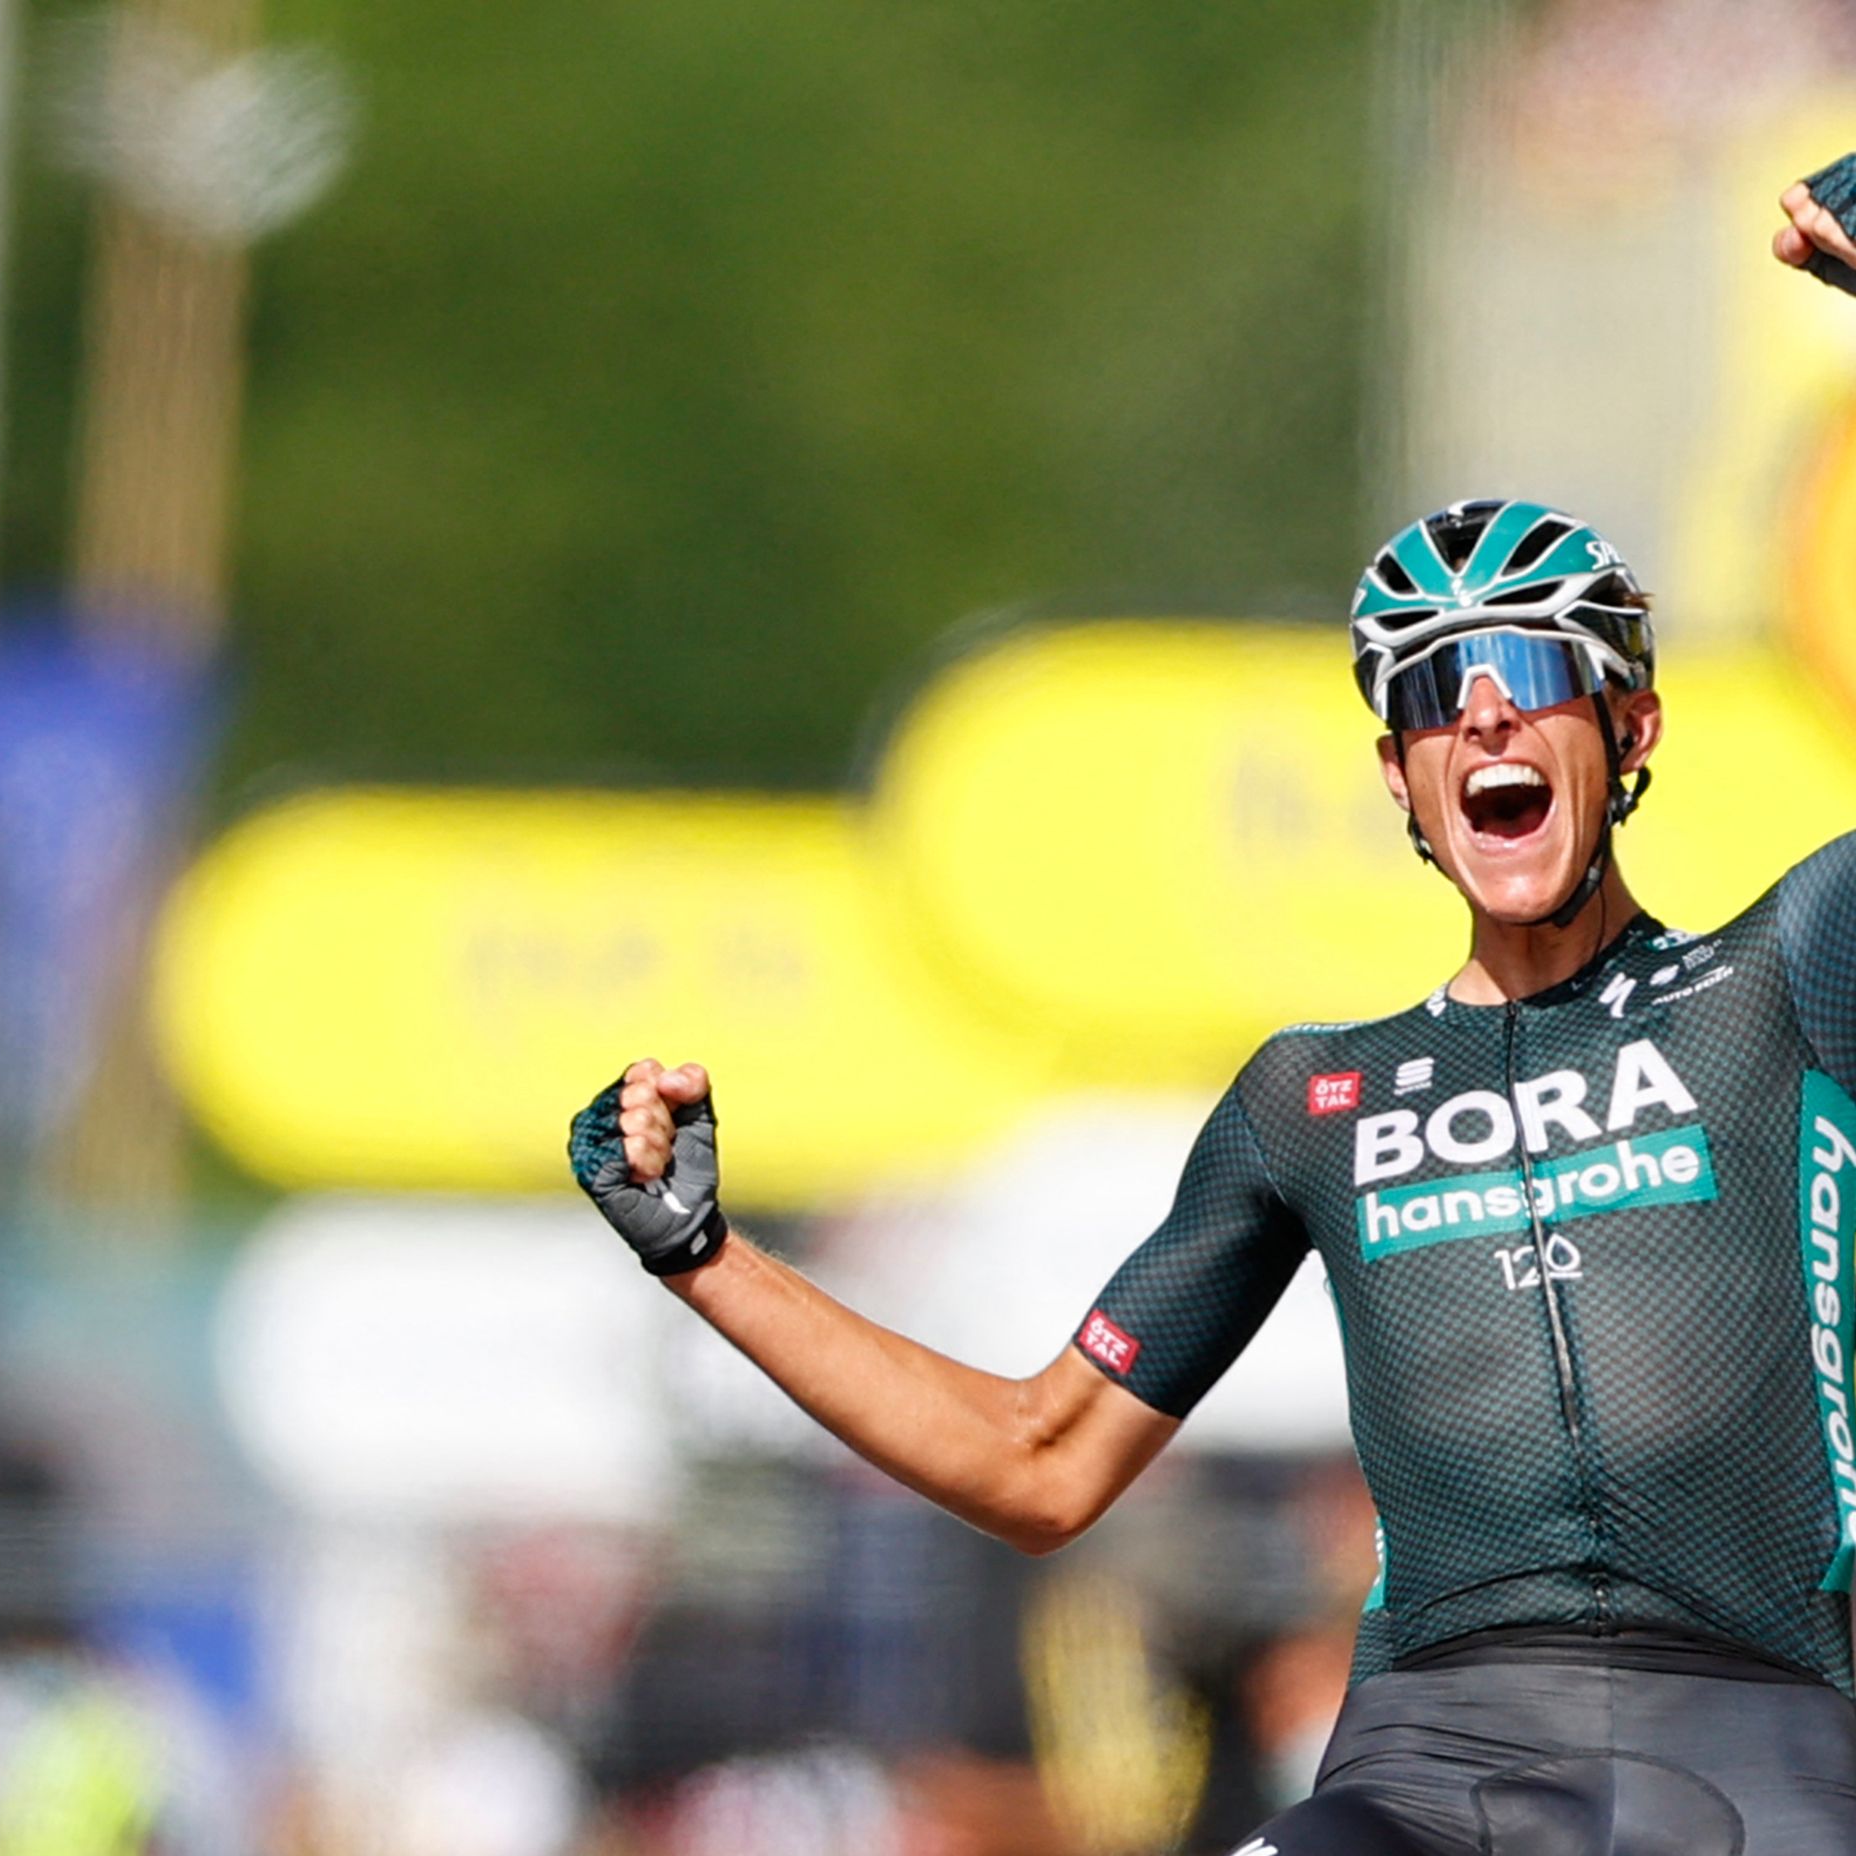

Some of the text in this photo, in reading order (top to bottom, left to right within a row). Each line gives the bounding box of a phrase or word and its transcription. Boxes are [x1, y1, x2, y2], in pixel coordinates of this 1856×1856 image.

[1315, 1094, 1352, 1109] TAL
[1355, 1039, 1698, 1187] BORA
[1365, 1143, 1700, 1246] hansgrohe
